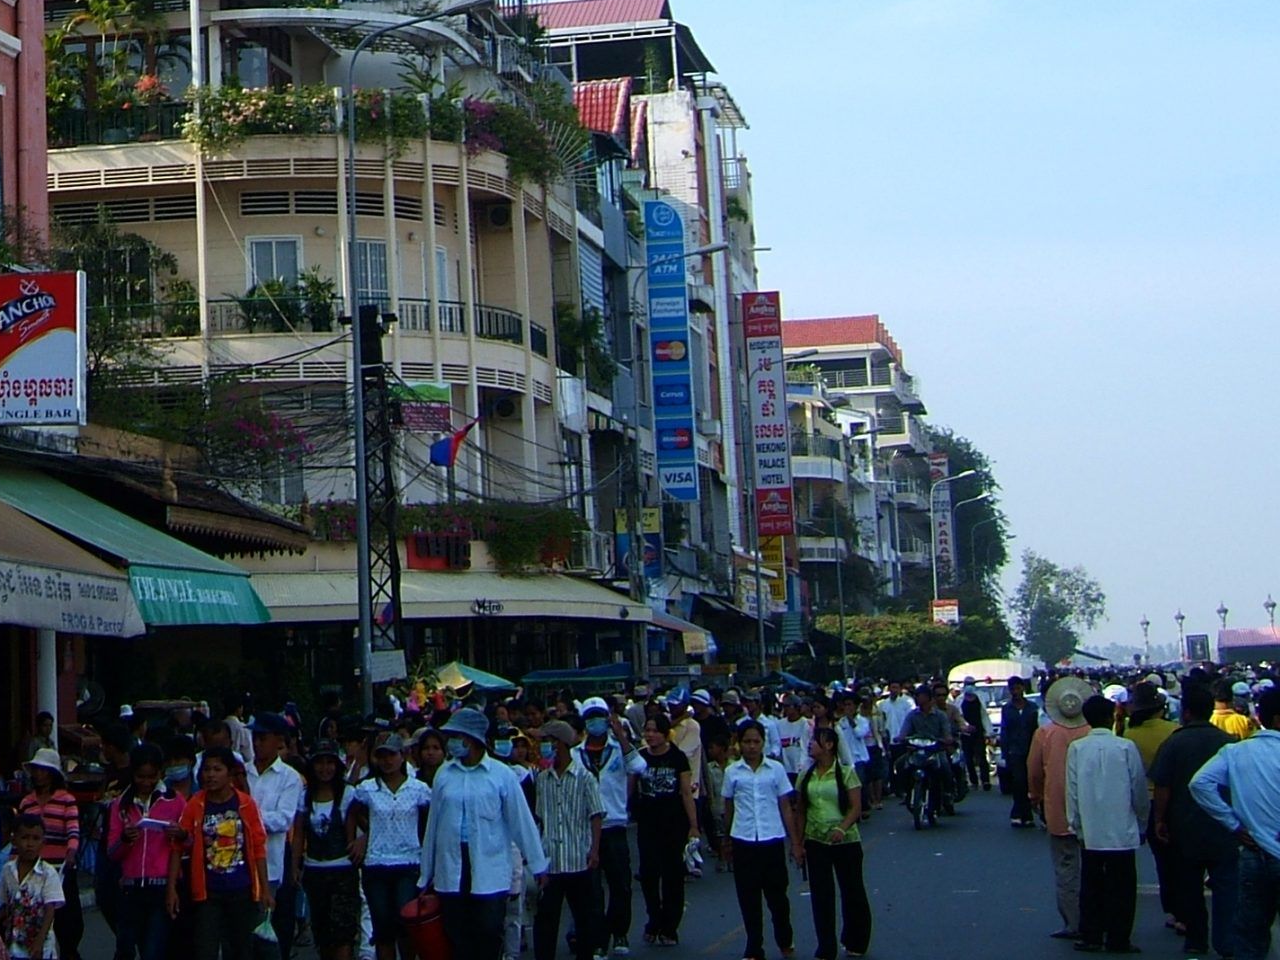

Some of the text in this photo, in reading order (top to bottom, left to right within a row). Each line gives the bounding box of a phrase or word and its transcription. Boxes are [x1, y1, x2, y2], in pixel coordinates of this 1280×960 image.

[654, 265, 678, 274] ATM
[45, 408, 72, 418] BAR
[756, 442, 786, 453] MEKONG
[758, 458, 785, 469] PALACE
[664, 471, 693, 483] VISA
[761, 473, 785, 484] HOTEL
[61, 611, 87, 629] FROG
